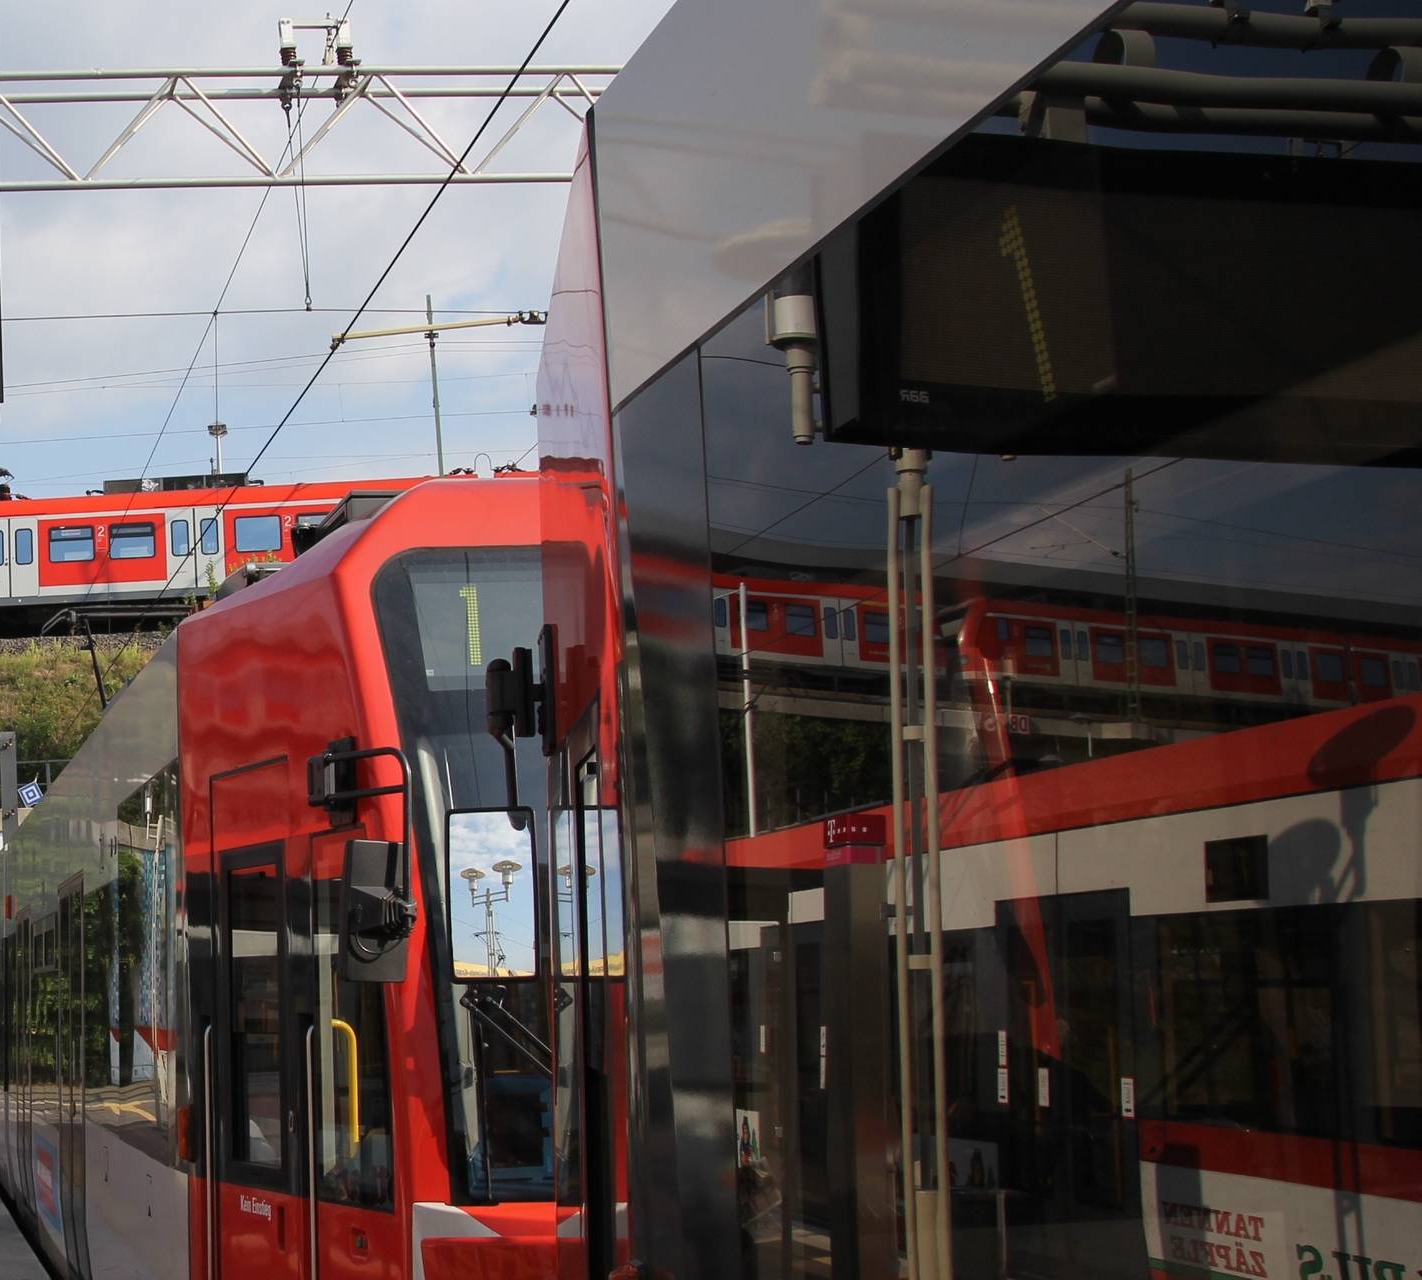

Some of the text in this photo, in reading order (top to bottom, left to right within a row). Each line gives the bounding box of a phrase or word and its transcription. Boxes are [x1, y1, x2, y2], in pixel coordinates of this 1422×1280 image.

[284, 515, 291, 527] 2
[97, 526, 105, 537] 2
[460, 584, 481, 665] 1
[240, 1194, 271, 1221] Kein Einstieg
